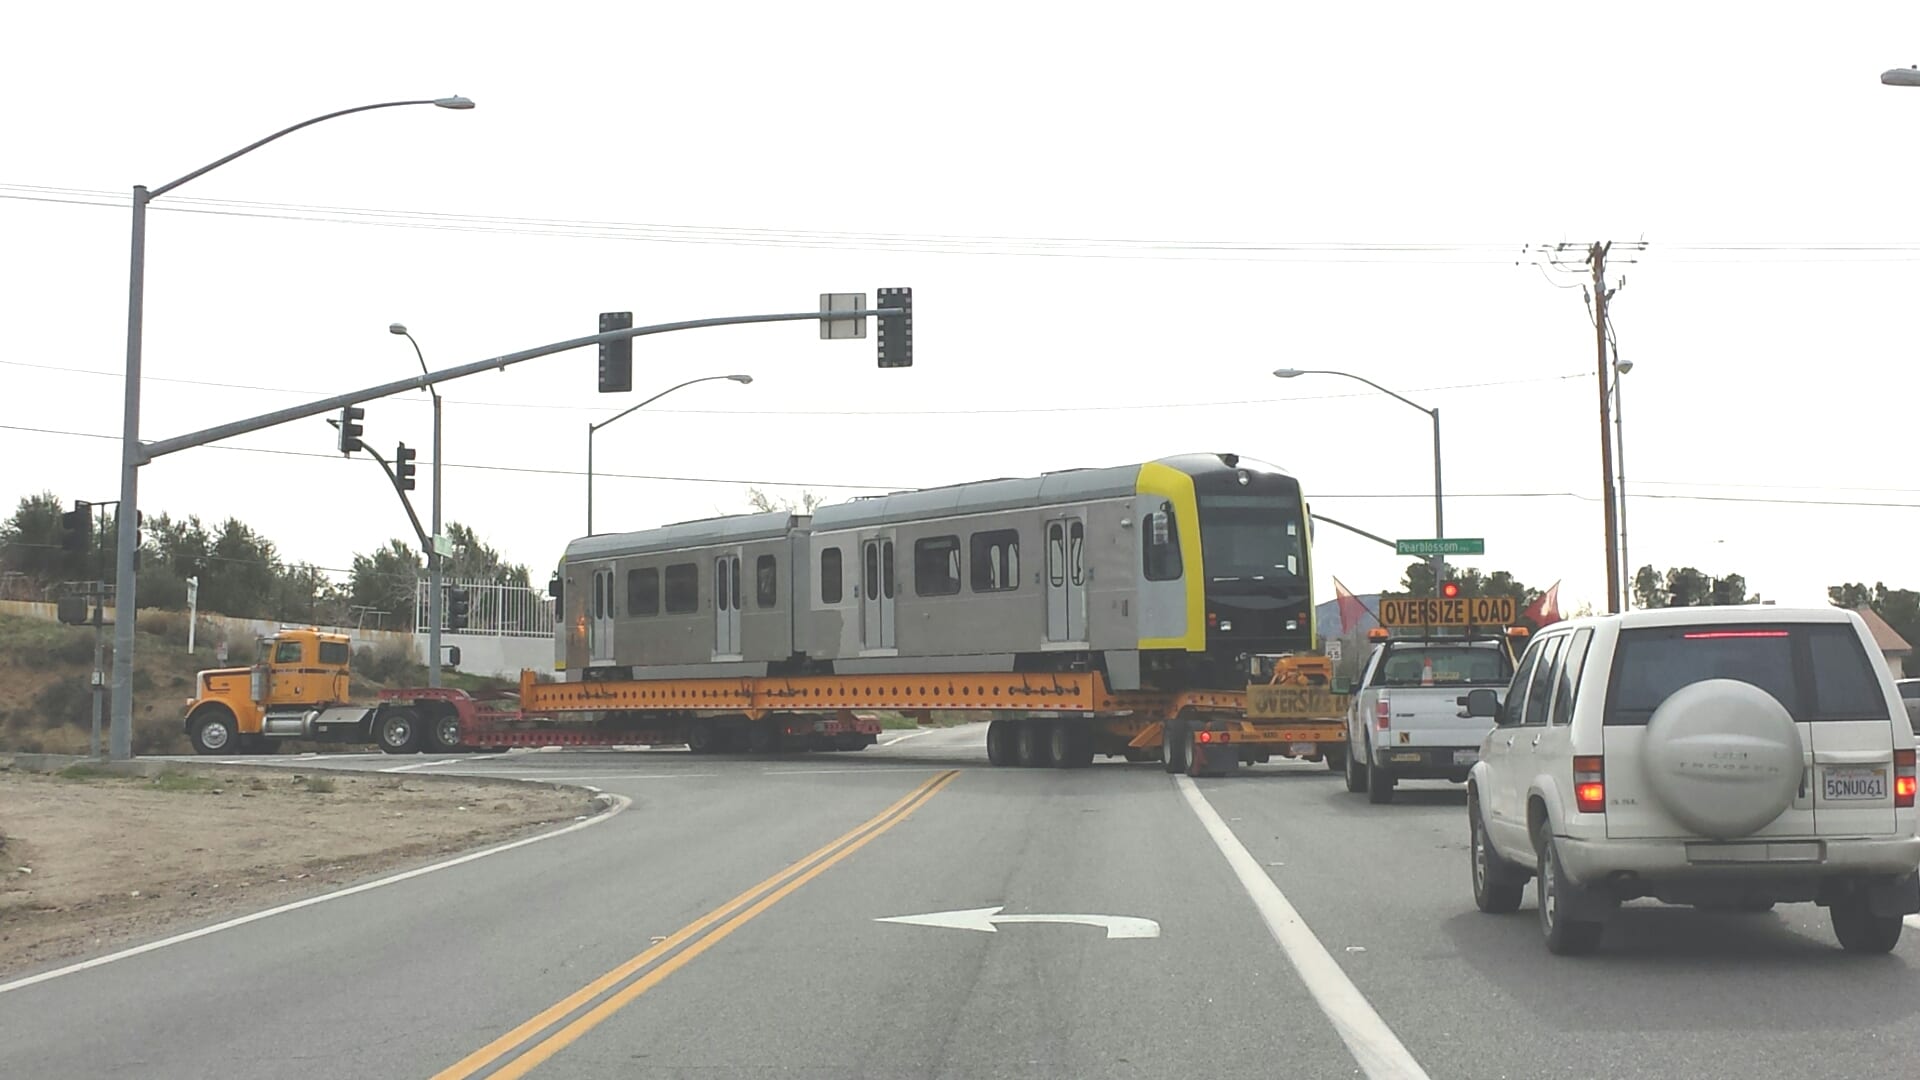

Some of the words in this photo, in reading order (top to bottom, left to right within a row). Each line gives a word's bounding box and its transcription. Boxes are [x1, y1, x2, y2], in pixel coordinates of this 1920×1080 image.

[1399, 541, 1458, 553] Pearblossom
[1385, 600, 1464, 624] OVERSIZE
[1470, 599, 1512, 623] LOAD
[1256, 687, 1331, 713] OVERSIZE
[1827, 779, 1883, 796] 5CNU061
